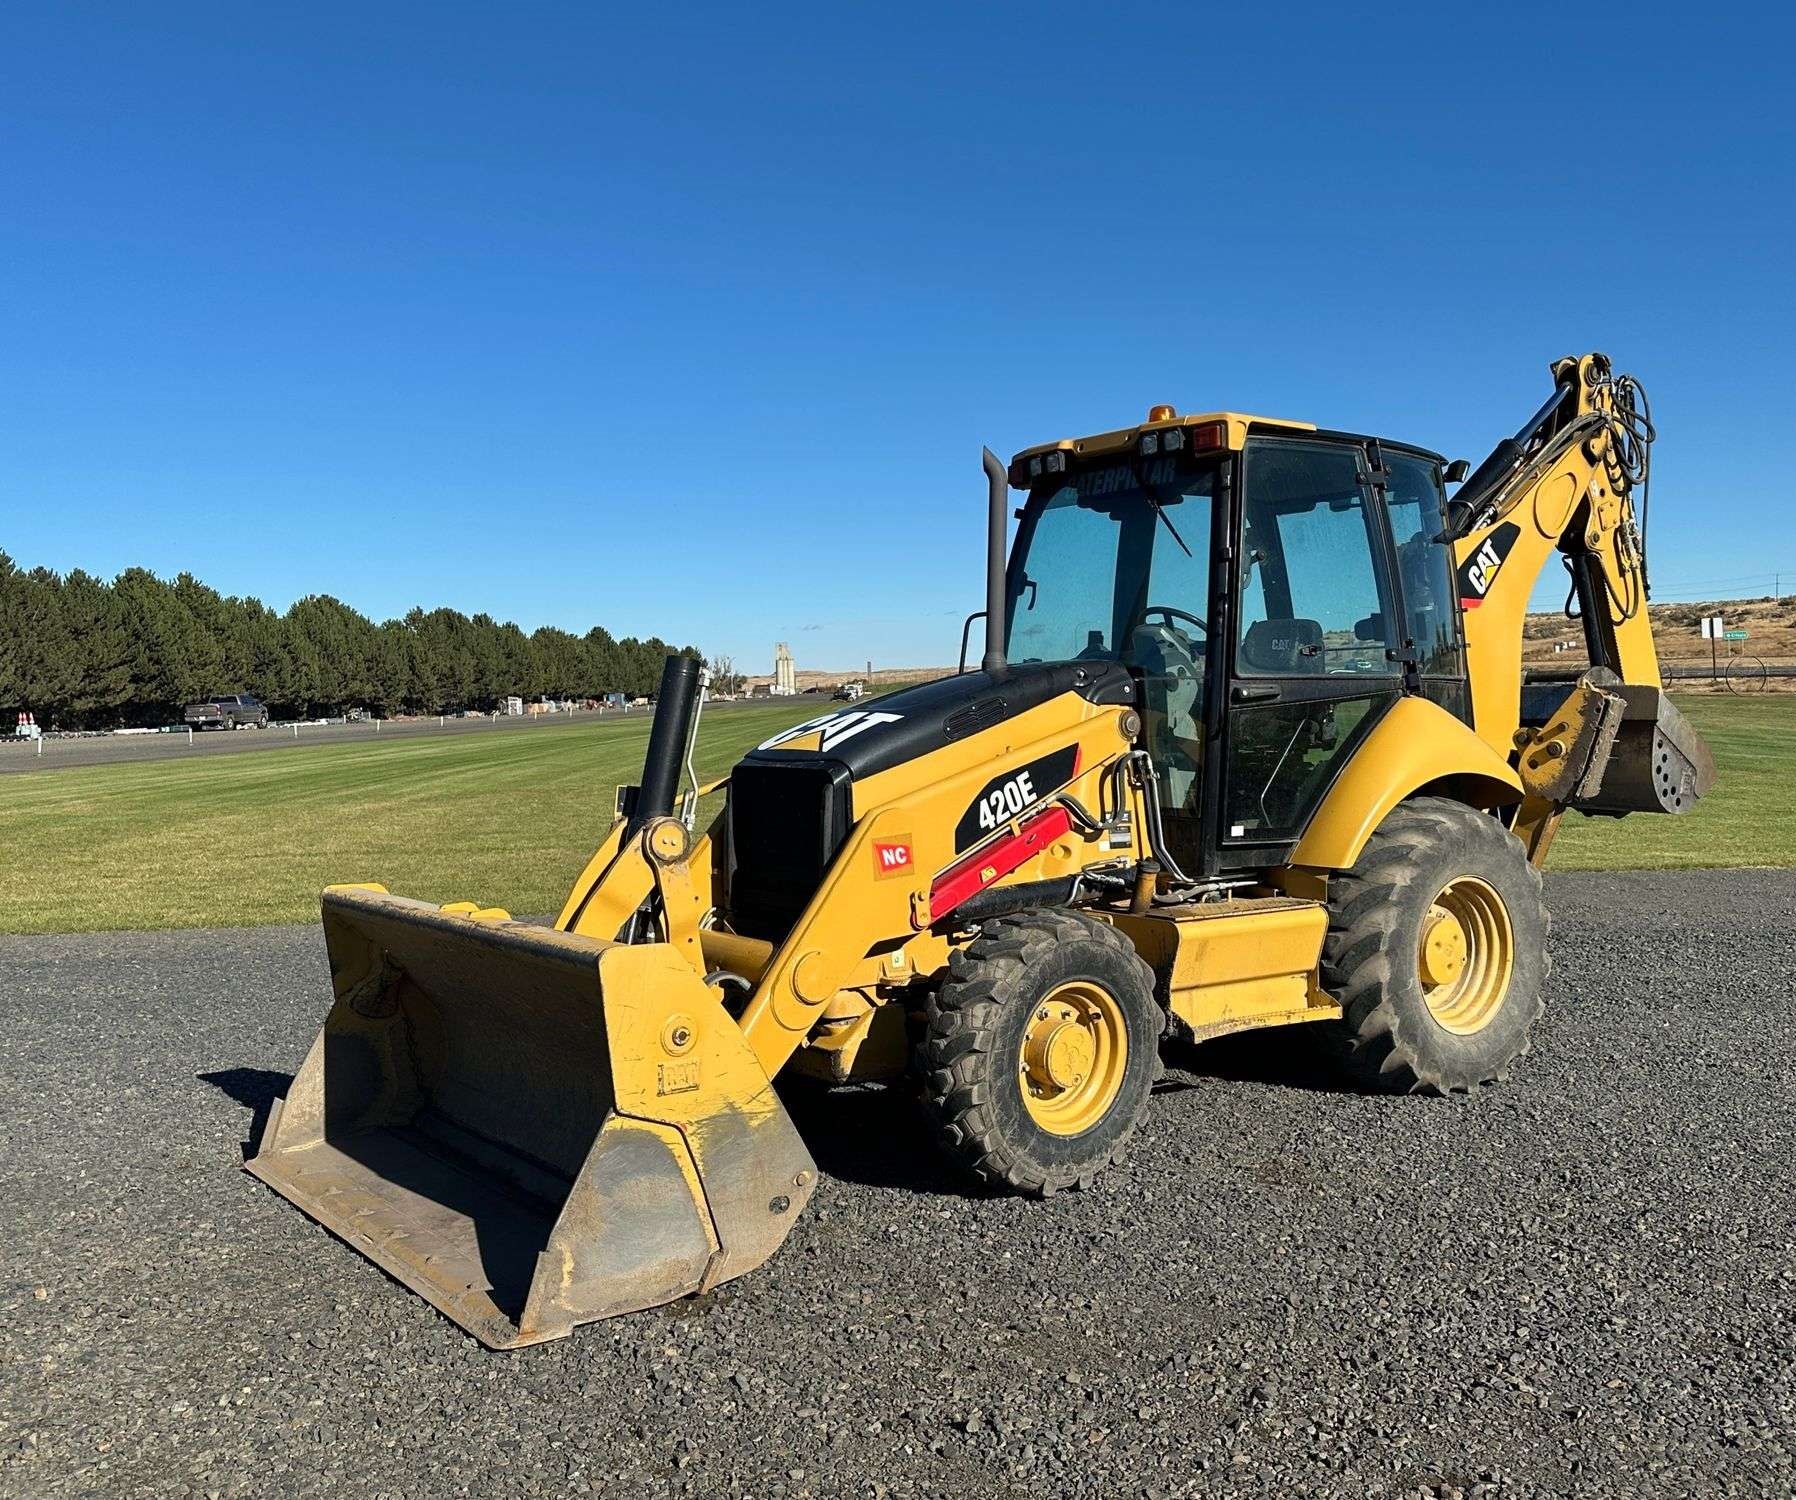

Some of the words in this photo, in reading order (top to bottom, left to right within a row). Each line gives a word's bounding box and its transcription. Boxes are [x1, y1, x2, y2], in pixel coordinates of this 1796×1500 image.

[1468, 537, 1502, 595] CAT
[1271, 639, 1290, 651] CAT
[757, 711, 905, 753] CAT
[979, 770, 1038, 829] 420E
[881, 846, 907, 866] NC
